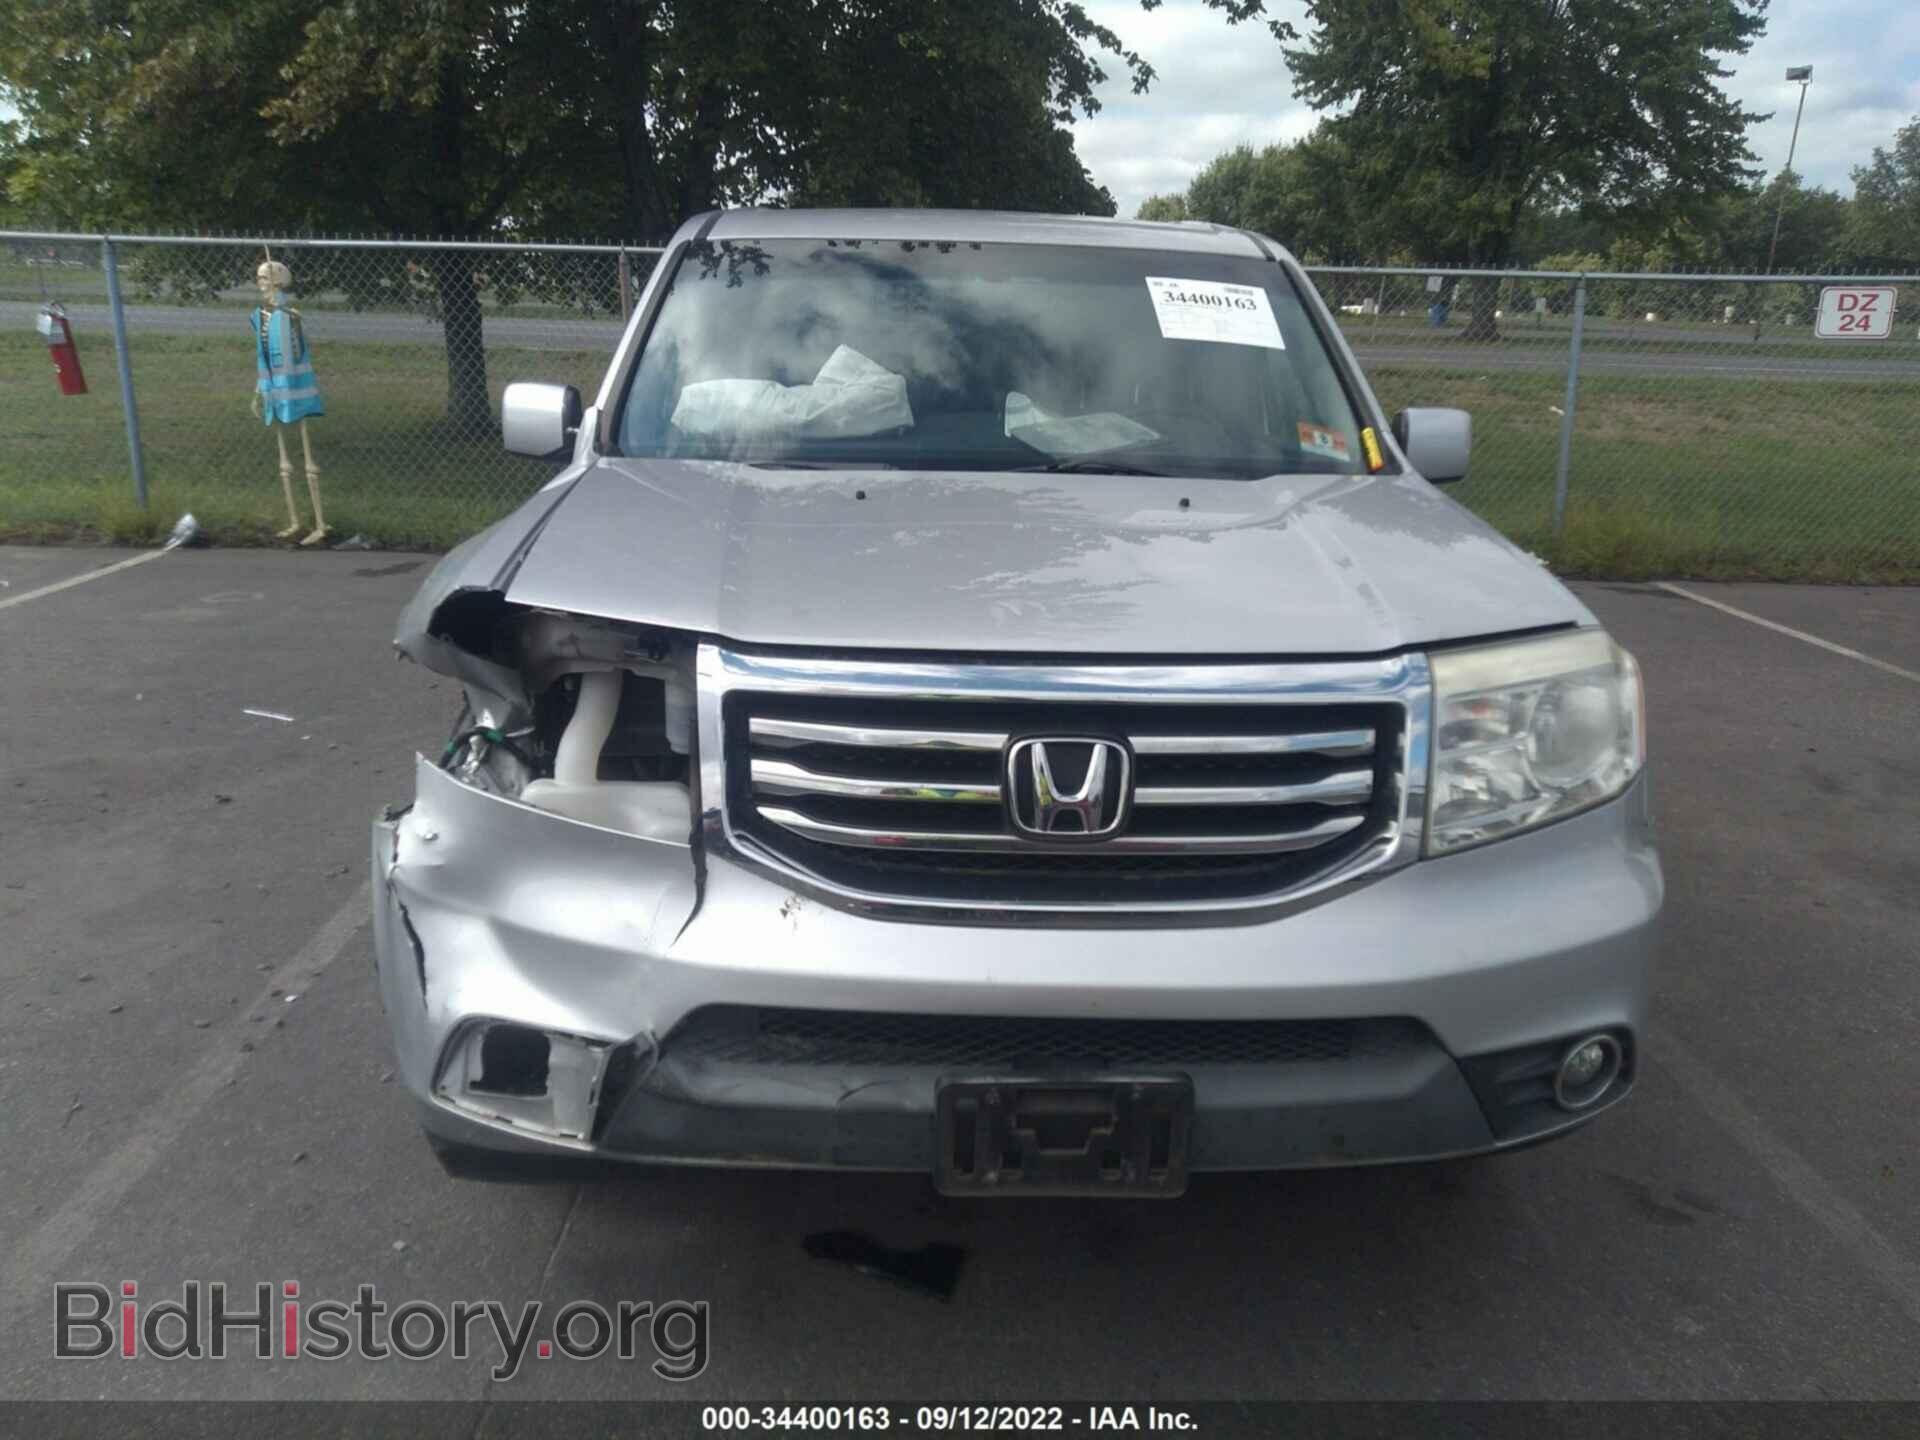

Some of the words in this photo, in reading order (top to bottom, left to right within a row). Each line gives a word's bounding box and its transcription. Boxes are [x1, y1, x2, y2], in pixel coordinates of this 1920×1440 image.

[1162, 290, 1257, 311] 34400163
[1837, 293, 1880, 312] DZ
[1838, 314, 1872, 332] 24
